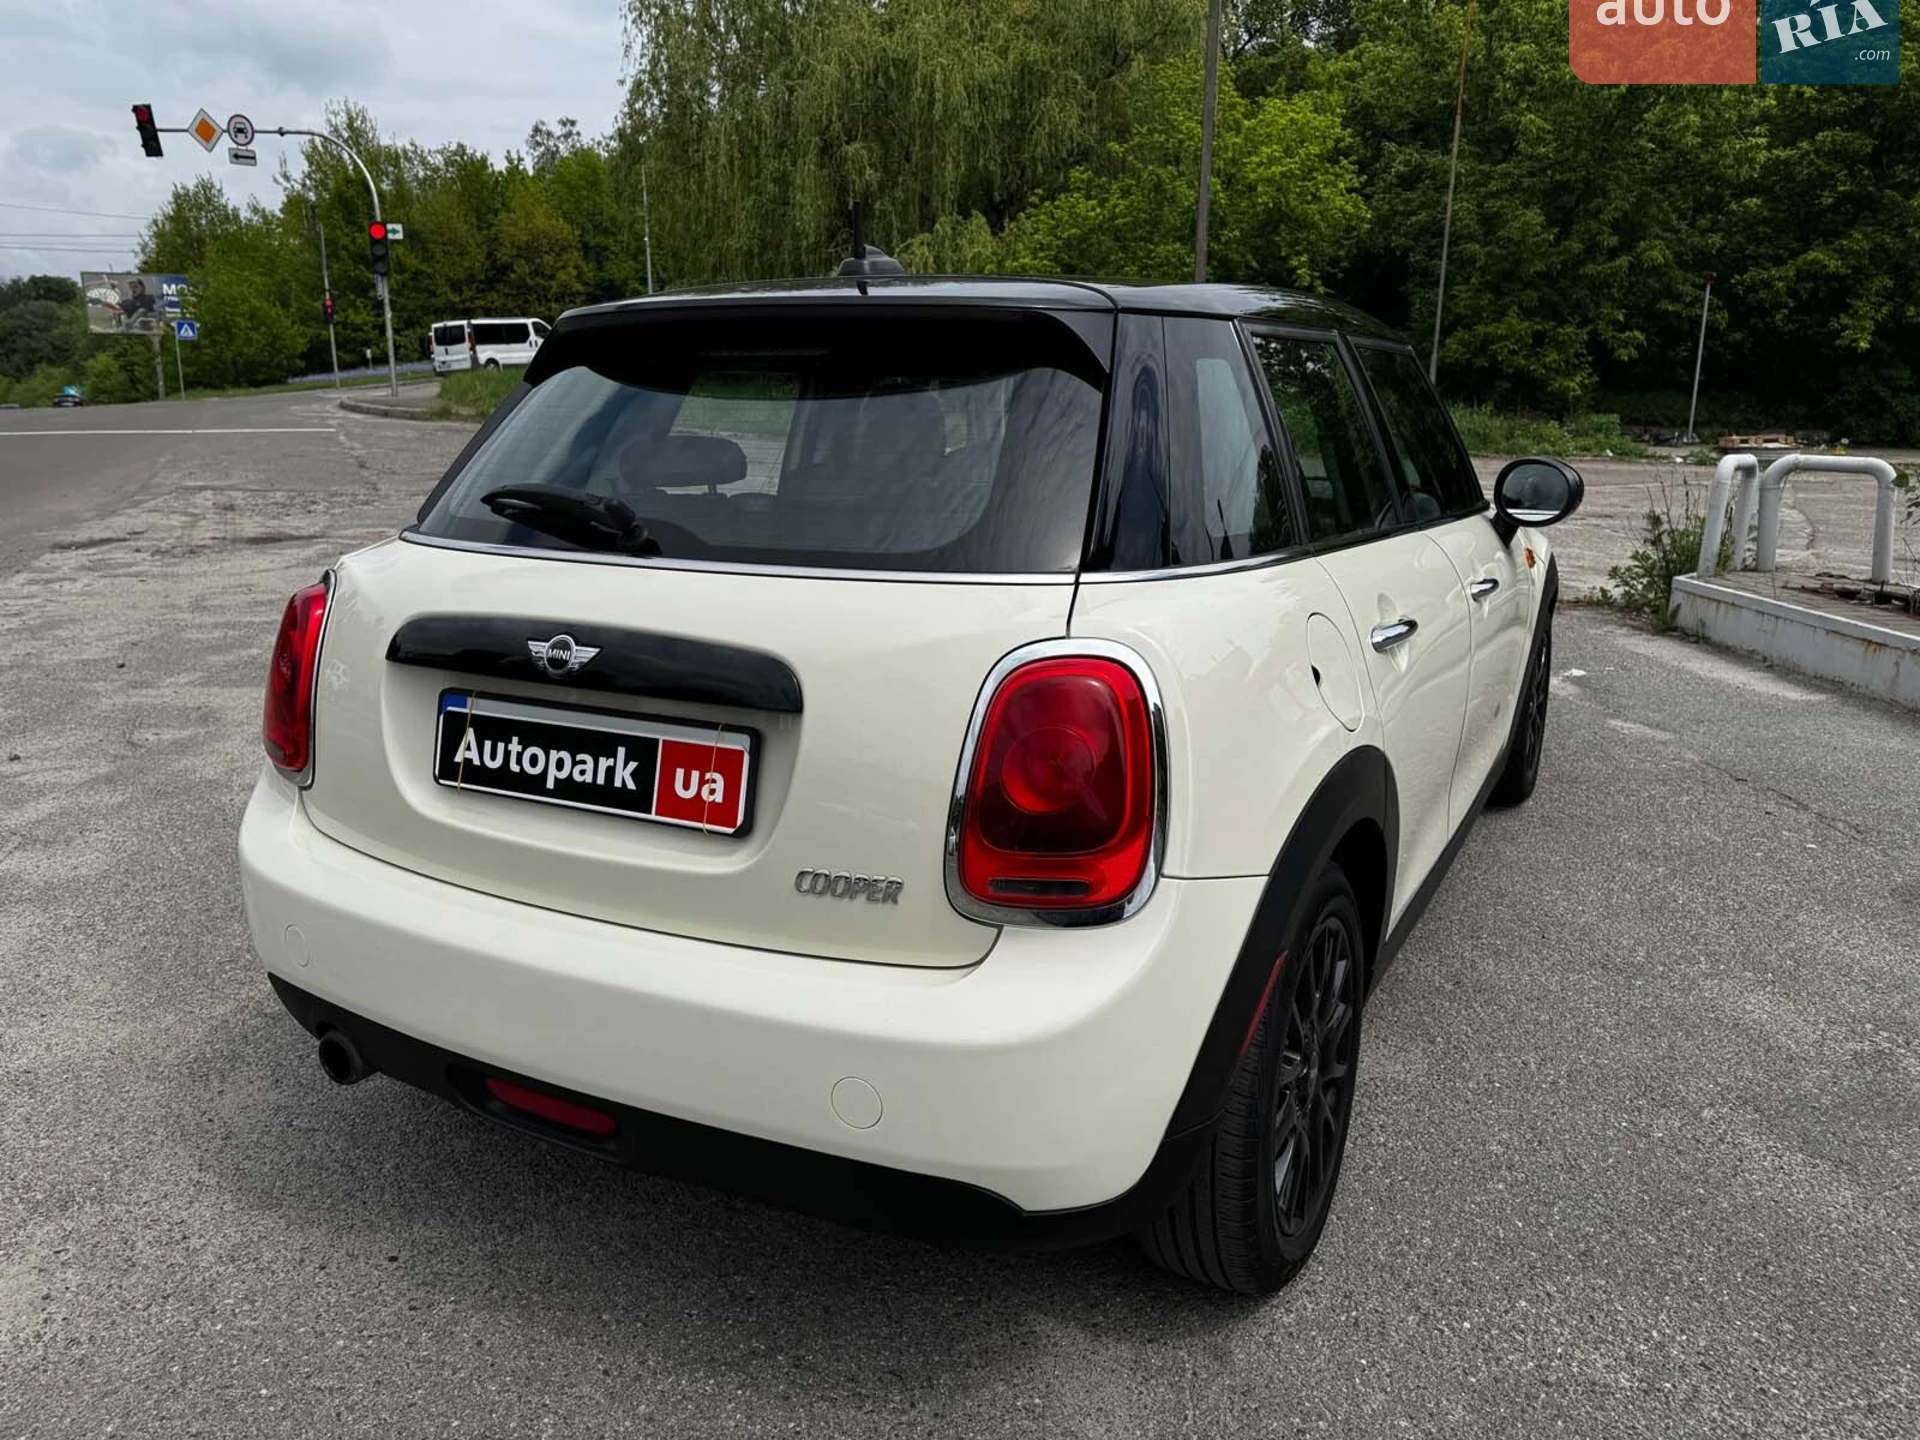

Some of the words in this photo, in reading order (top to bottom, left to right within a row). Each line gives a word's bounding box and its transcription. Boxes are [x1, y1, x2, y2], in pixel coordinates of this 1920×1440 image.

[548, 648, 571, 661] MINI
[454, 727, 639, 790] Autopark
[674, 767, 725, 804] ua
[795, 868, 904, 905] COOPER
